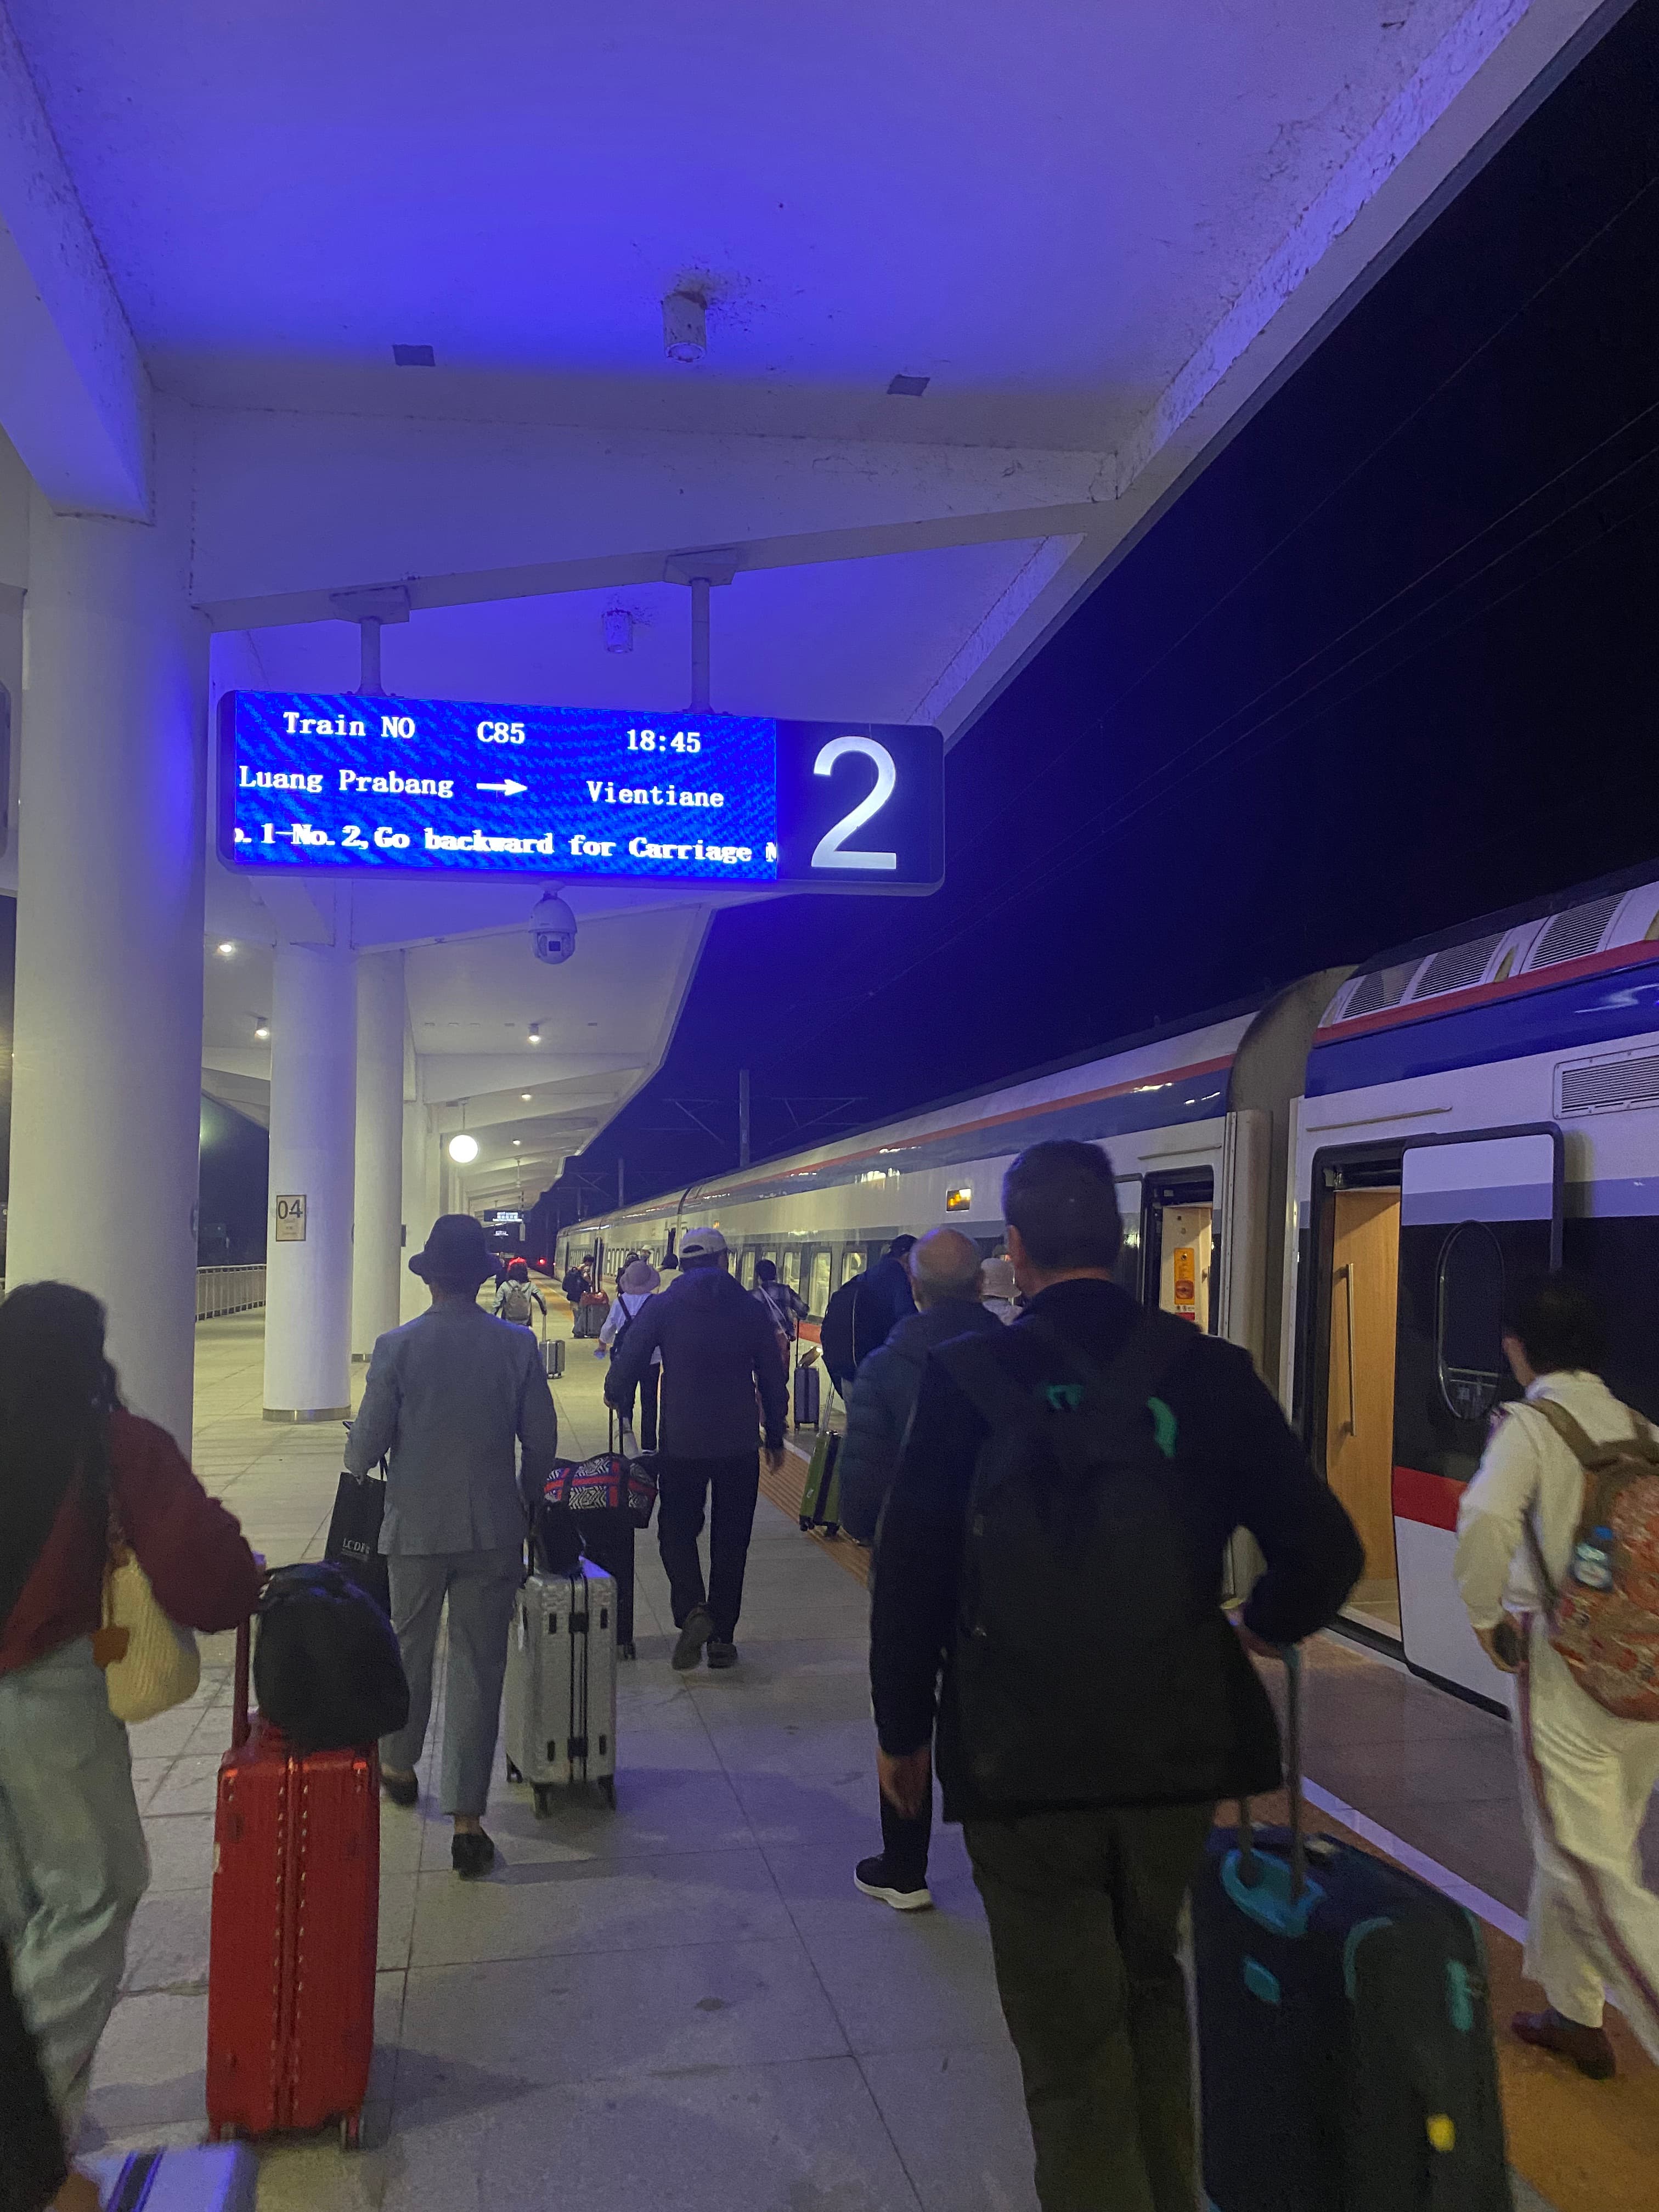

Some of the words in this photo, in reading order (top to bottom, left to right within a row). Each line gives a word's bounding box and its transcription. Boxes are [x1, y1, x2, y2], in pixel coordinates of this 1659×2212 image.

[283, 712, 366, 736] Train
[381, 716, 415, 738] NO
[477, 721, 525, 744] C85
[627, 729, 701, 753] 18:45
[239, 765, 323, 793] Luang
[338, 769, 454, 798] Prabang
[586, 781, 724, 807] Vientiane
[811, 736, 896, 870] 2
[424, 827, 555, 854] backward
[568, 834, 616, 856] for
[629, 837, 752, 864] Carriage
[278, 1199, 303, 1219] 04
